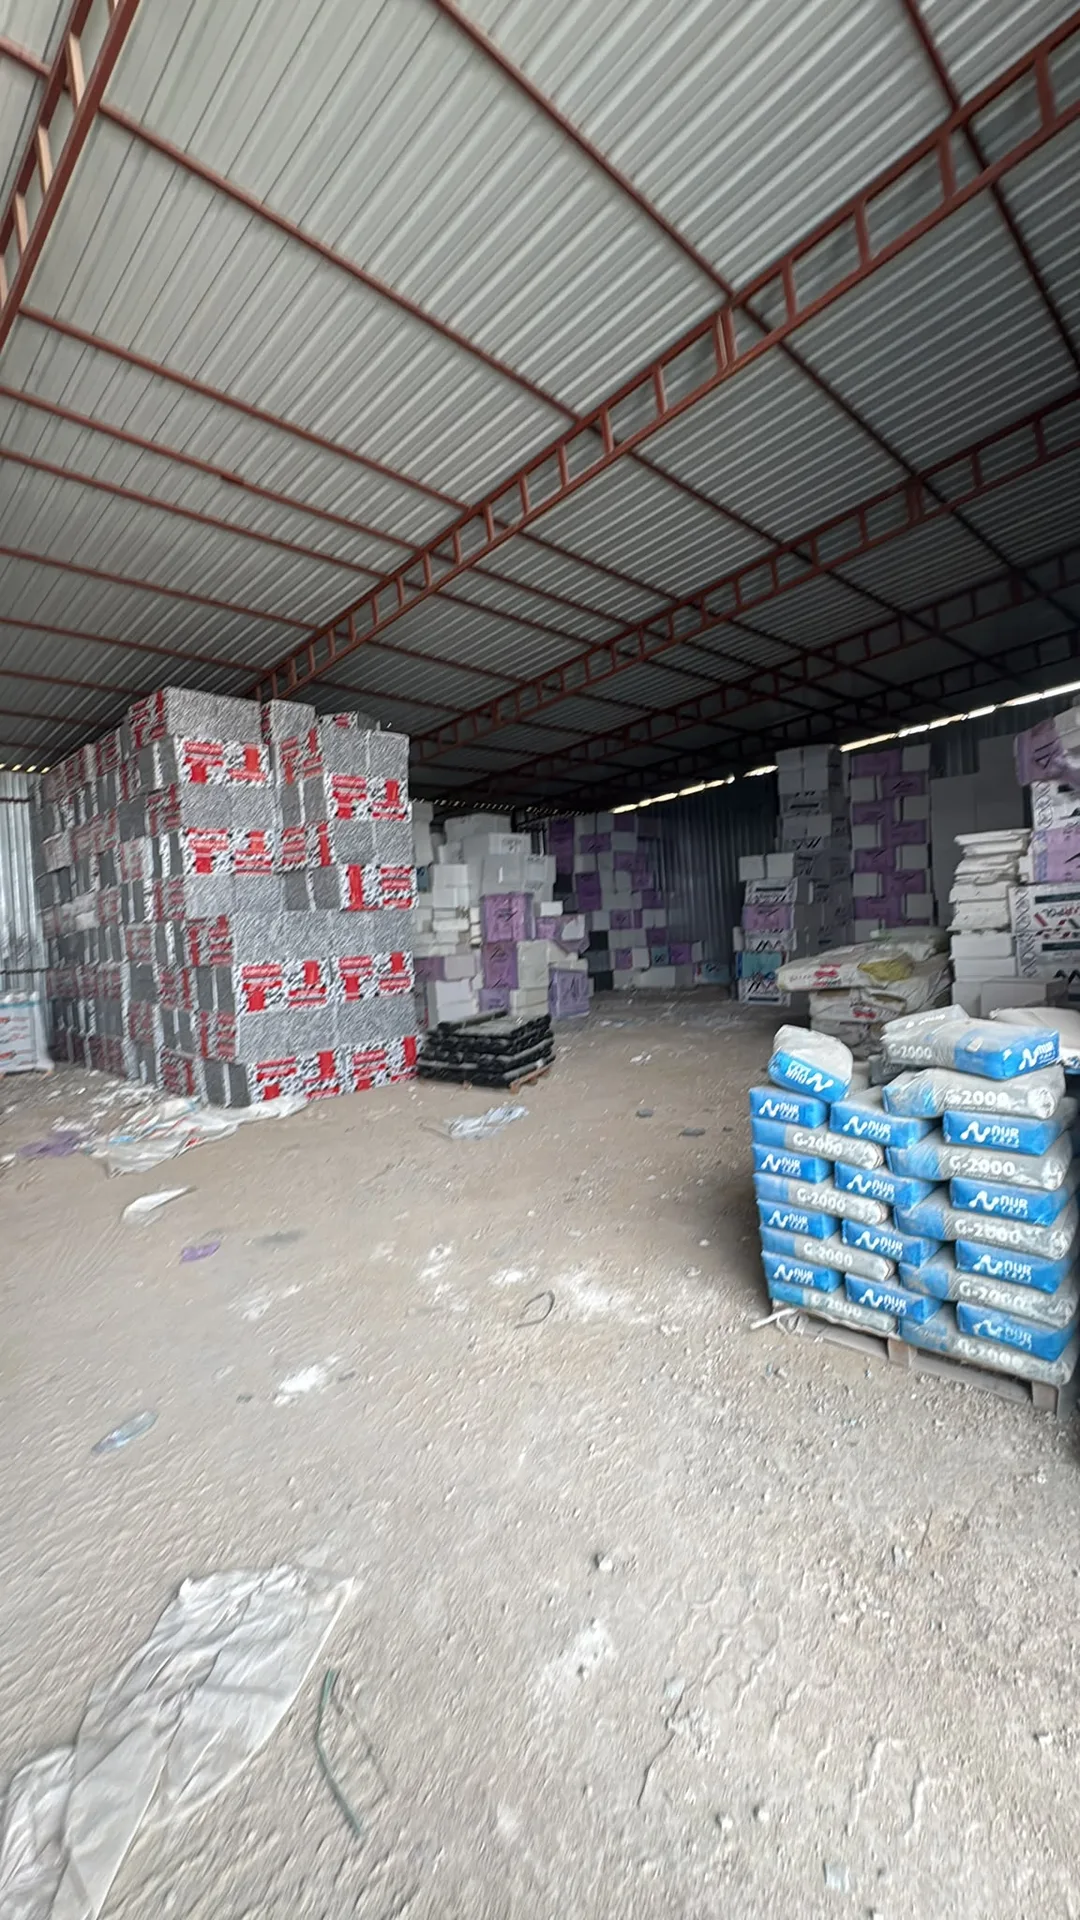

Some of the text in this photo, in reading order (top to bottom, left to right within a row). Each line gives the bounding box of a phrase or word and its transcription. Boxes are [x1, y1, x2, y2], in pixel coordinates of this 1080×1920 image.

[949, 1155, 1015, 1176] G-2000
[797, 1188, 846, 1213] G-2000
[954, 1218, 1021, 1244] G-2000
[803, 1242, 853, 1267] G-2000
